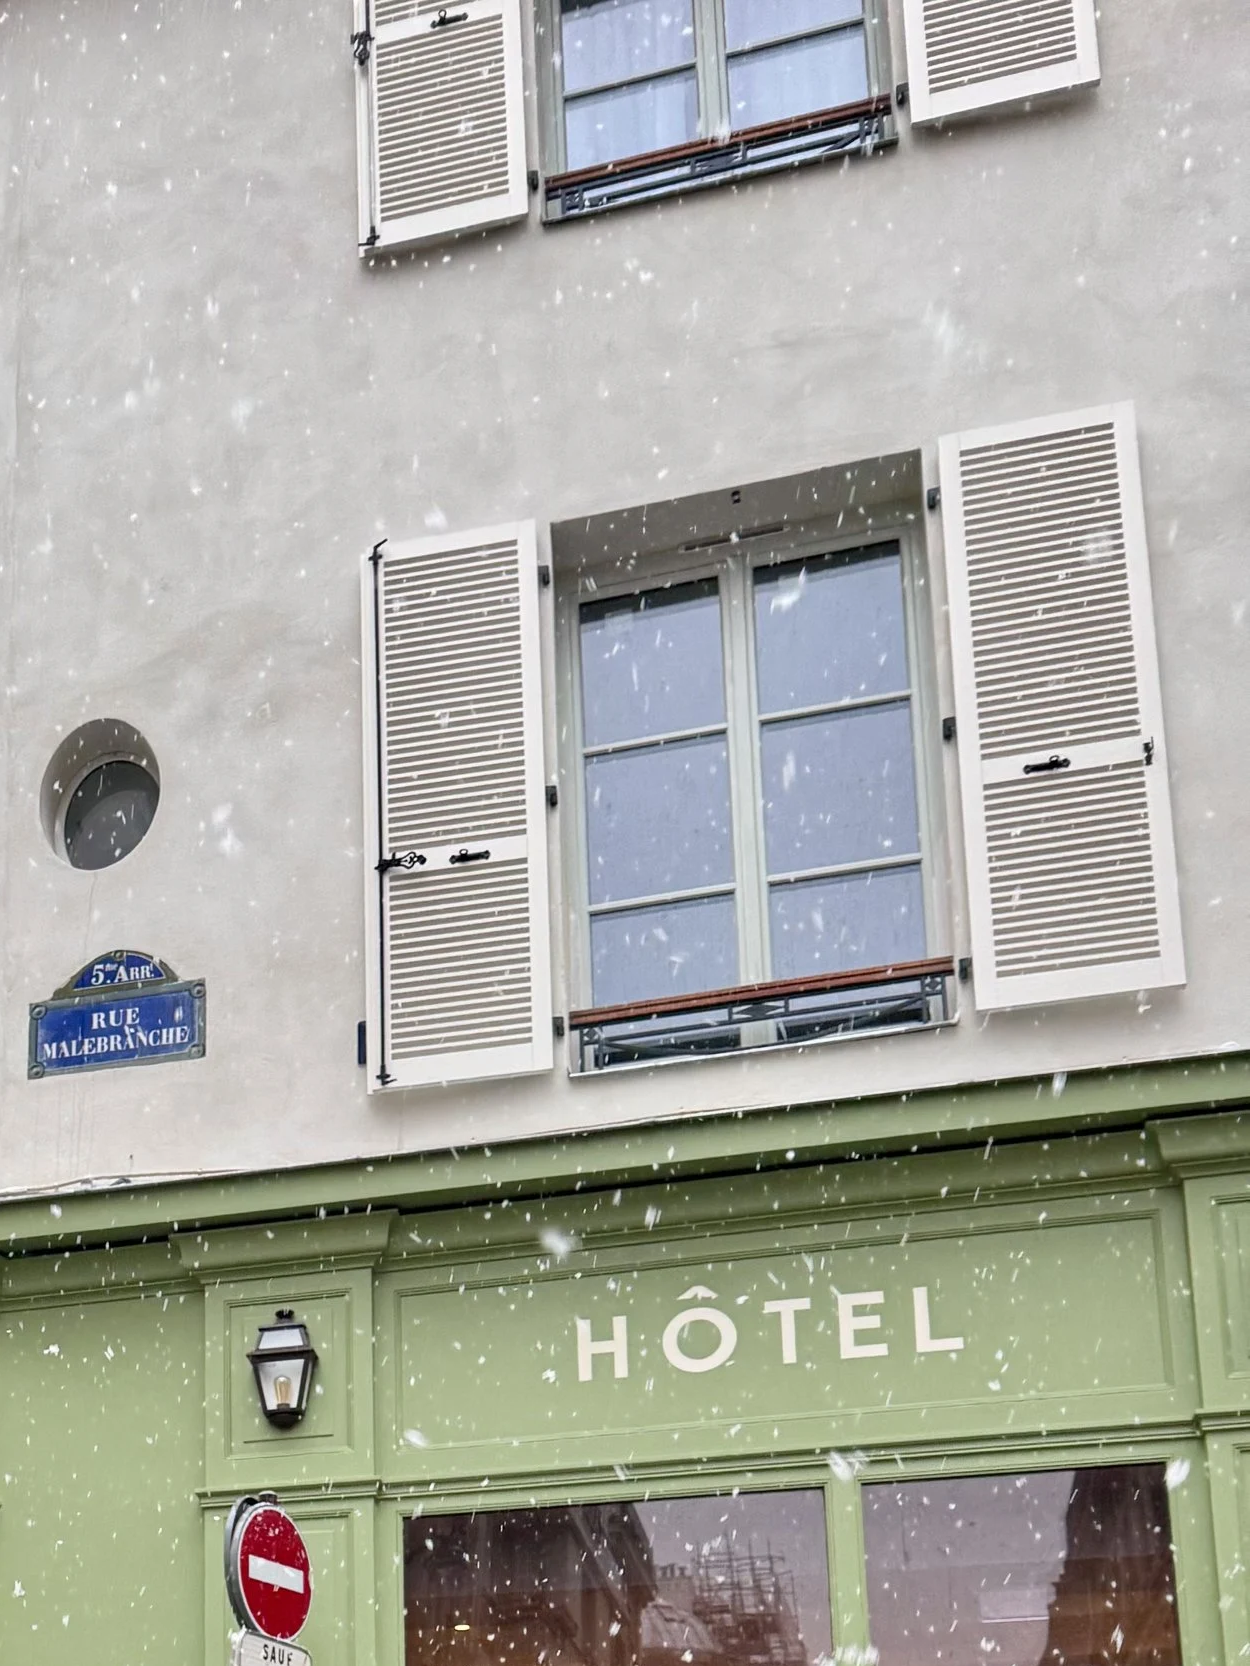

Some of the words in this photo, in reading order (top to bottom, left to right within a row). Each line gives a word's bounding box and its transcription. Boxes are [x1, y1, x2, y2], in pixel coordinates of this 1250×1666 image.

[91, 1007, 140, 1030] RUE
[42, 1025, 190, 1059] MALEBRANCHE
[576, 1285, 965, 1382] HÔTEL
[262, 1644, 293, 1666] SAUF
